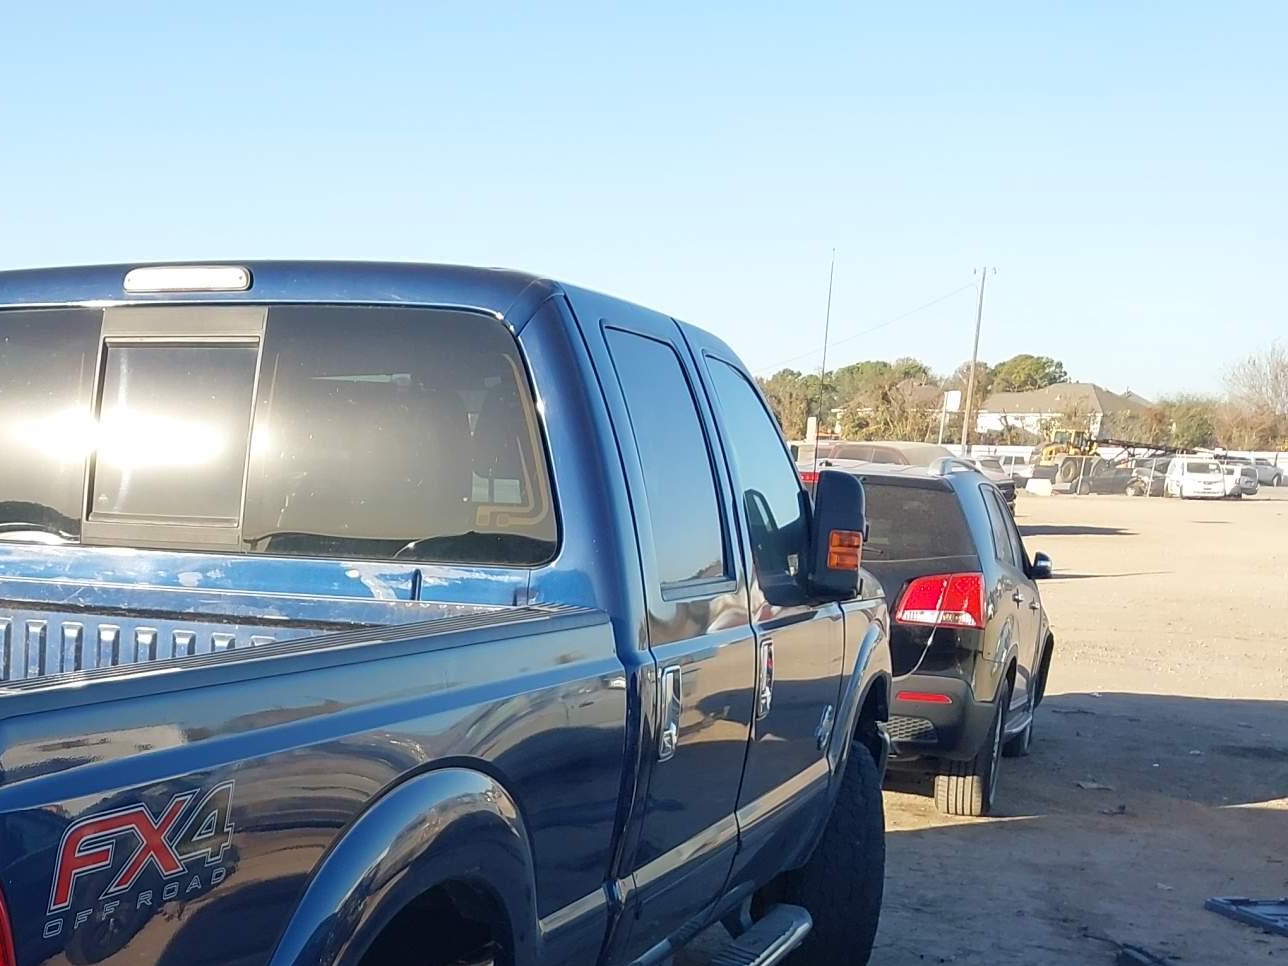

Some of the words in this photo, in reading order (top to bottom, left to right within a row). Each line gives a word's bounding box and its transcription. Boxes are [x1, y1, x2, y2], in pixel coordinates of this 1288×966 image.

[47, 780, 236, 915] FX4
[43, 900, 121, 938] OFF
[137, 867, 226, 910] ROAD
